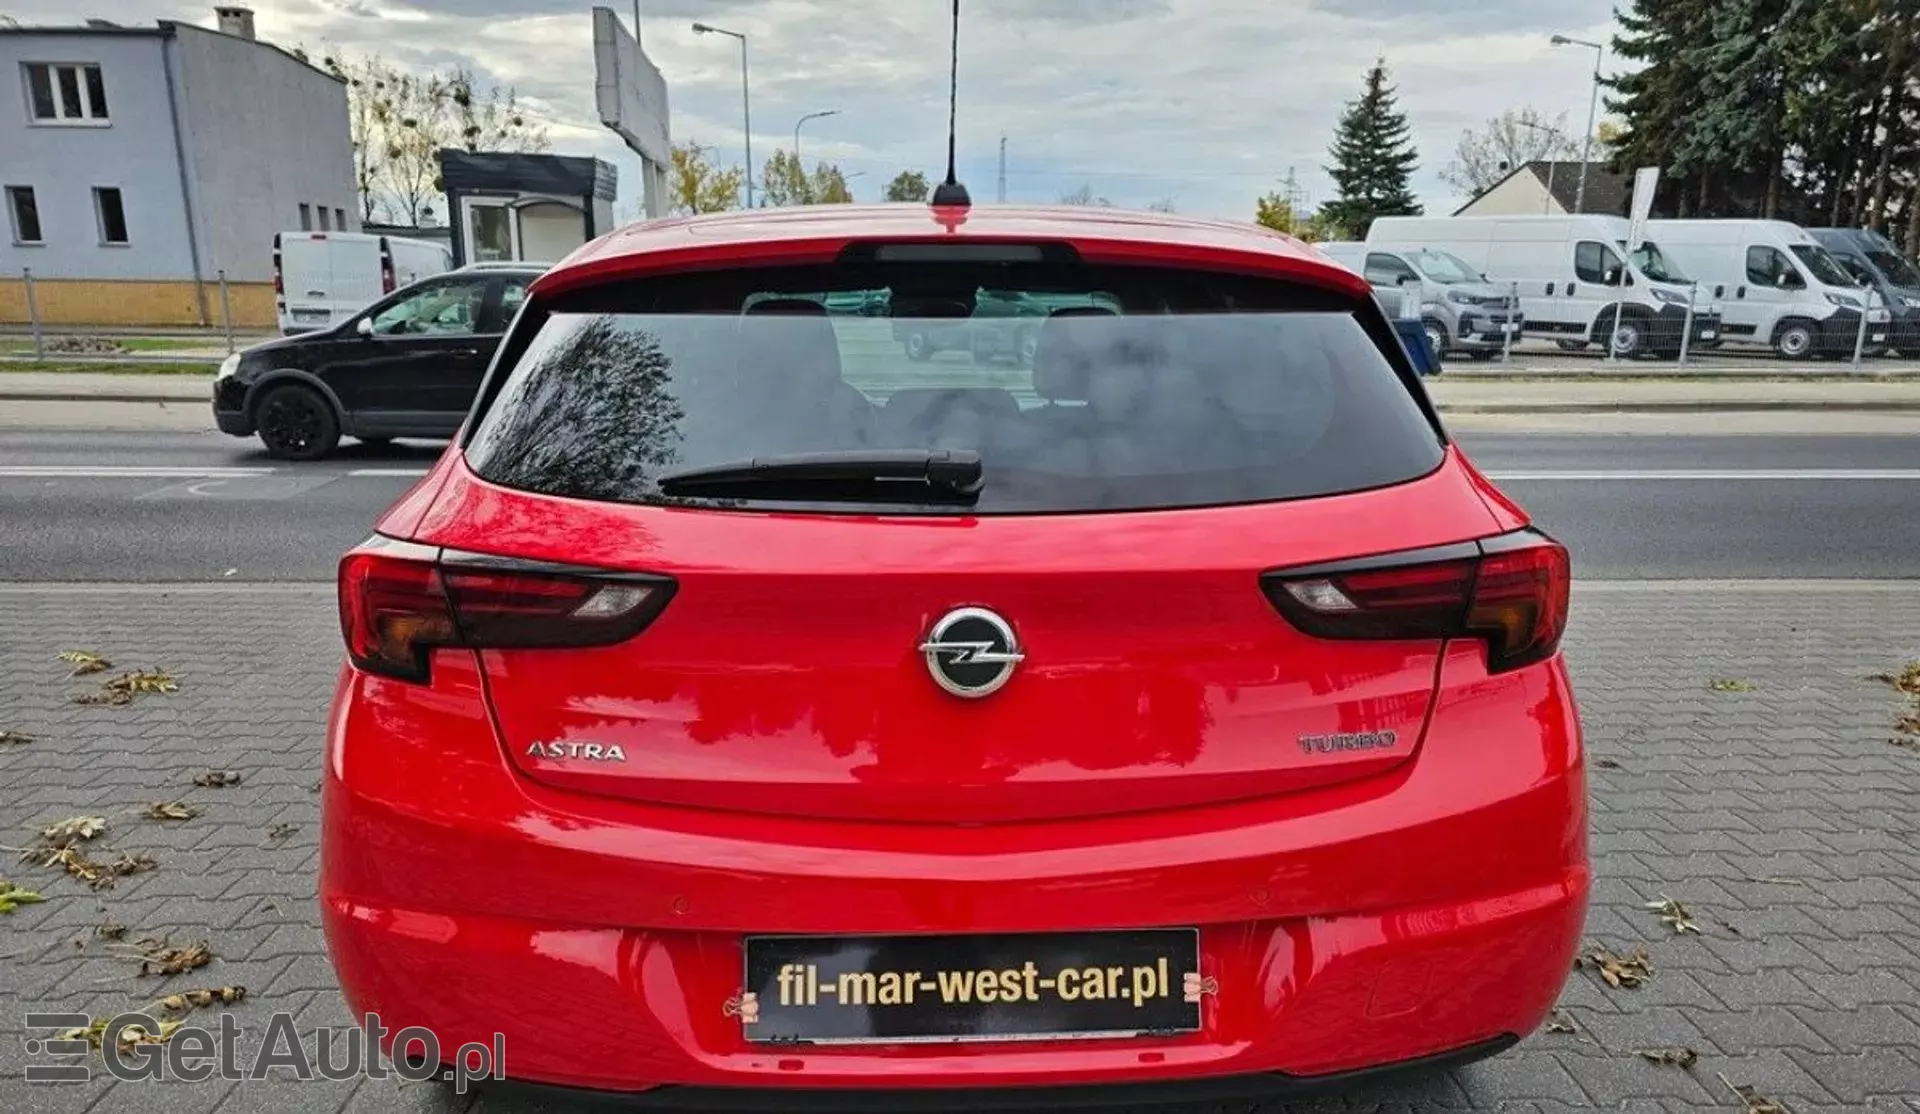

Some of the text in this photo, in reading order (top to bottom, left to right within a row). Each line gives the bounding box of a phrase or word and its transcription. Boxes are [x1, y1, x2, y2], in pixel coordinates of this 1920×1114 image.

[525, 740, 626, 762] ASTRA
[1298, 729, 1396, 754] TURBO
[777, 957, 1169, 1008] fil-mar-west-car.pl
